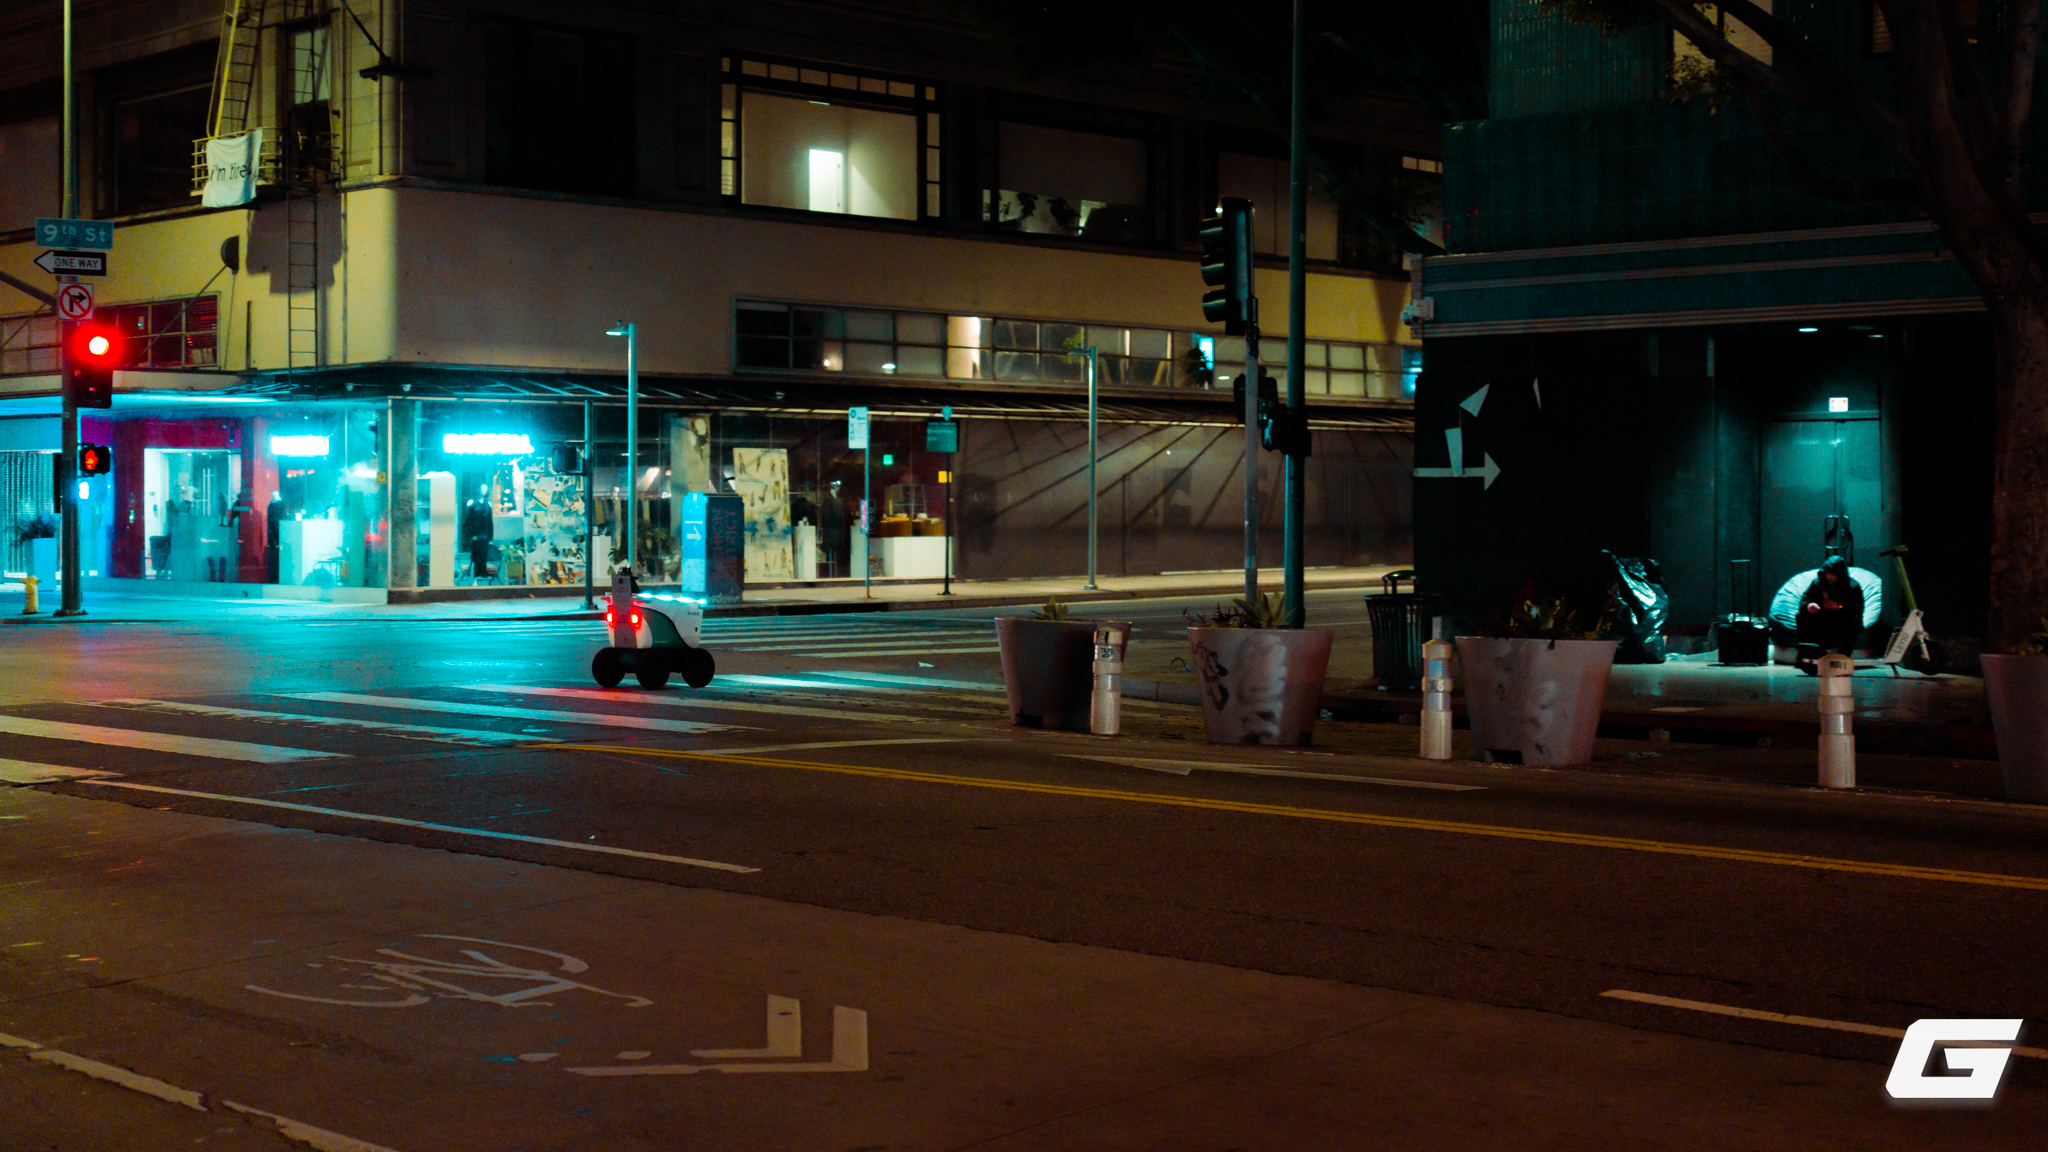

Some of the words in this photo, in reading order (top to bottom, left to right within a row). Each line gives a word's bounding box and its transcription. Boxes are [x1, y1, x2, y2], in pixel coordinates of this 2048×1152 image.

[43, 224, 77, 242] 9th
[85, 227, 106, 242] St
[54, 257, 76, 267] ONE
[80, 258, 99, 268] WAY
